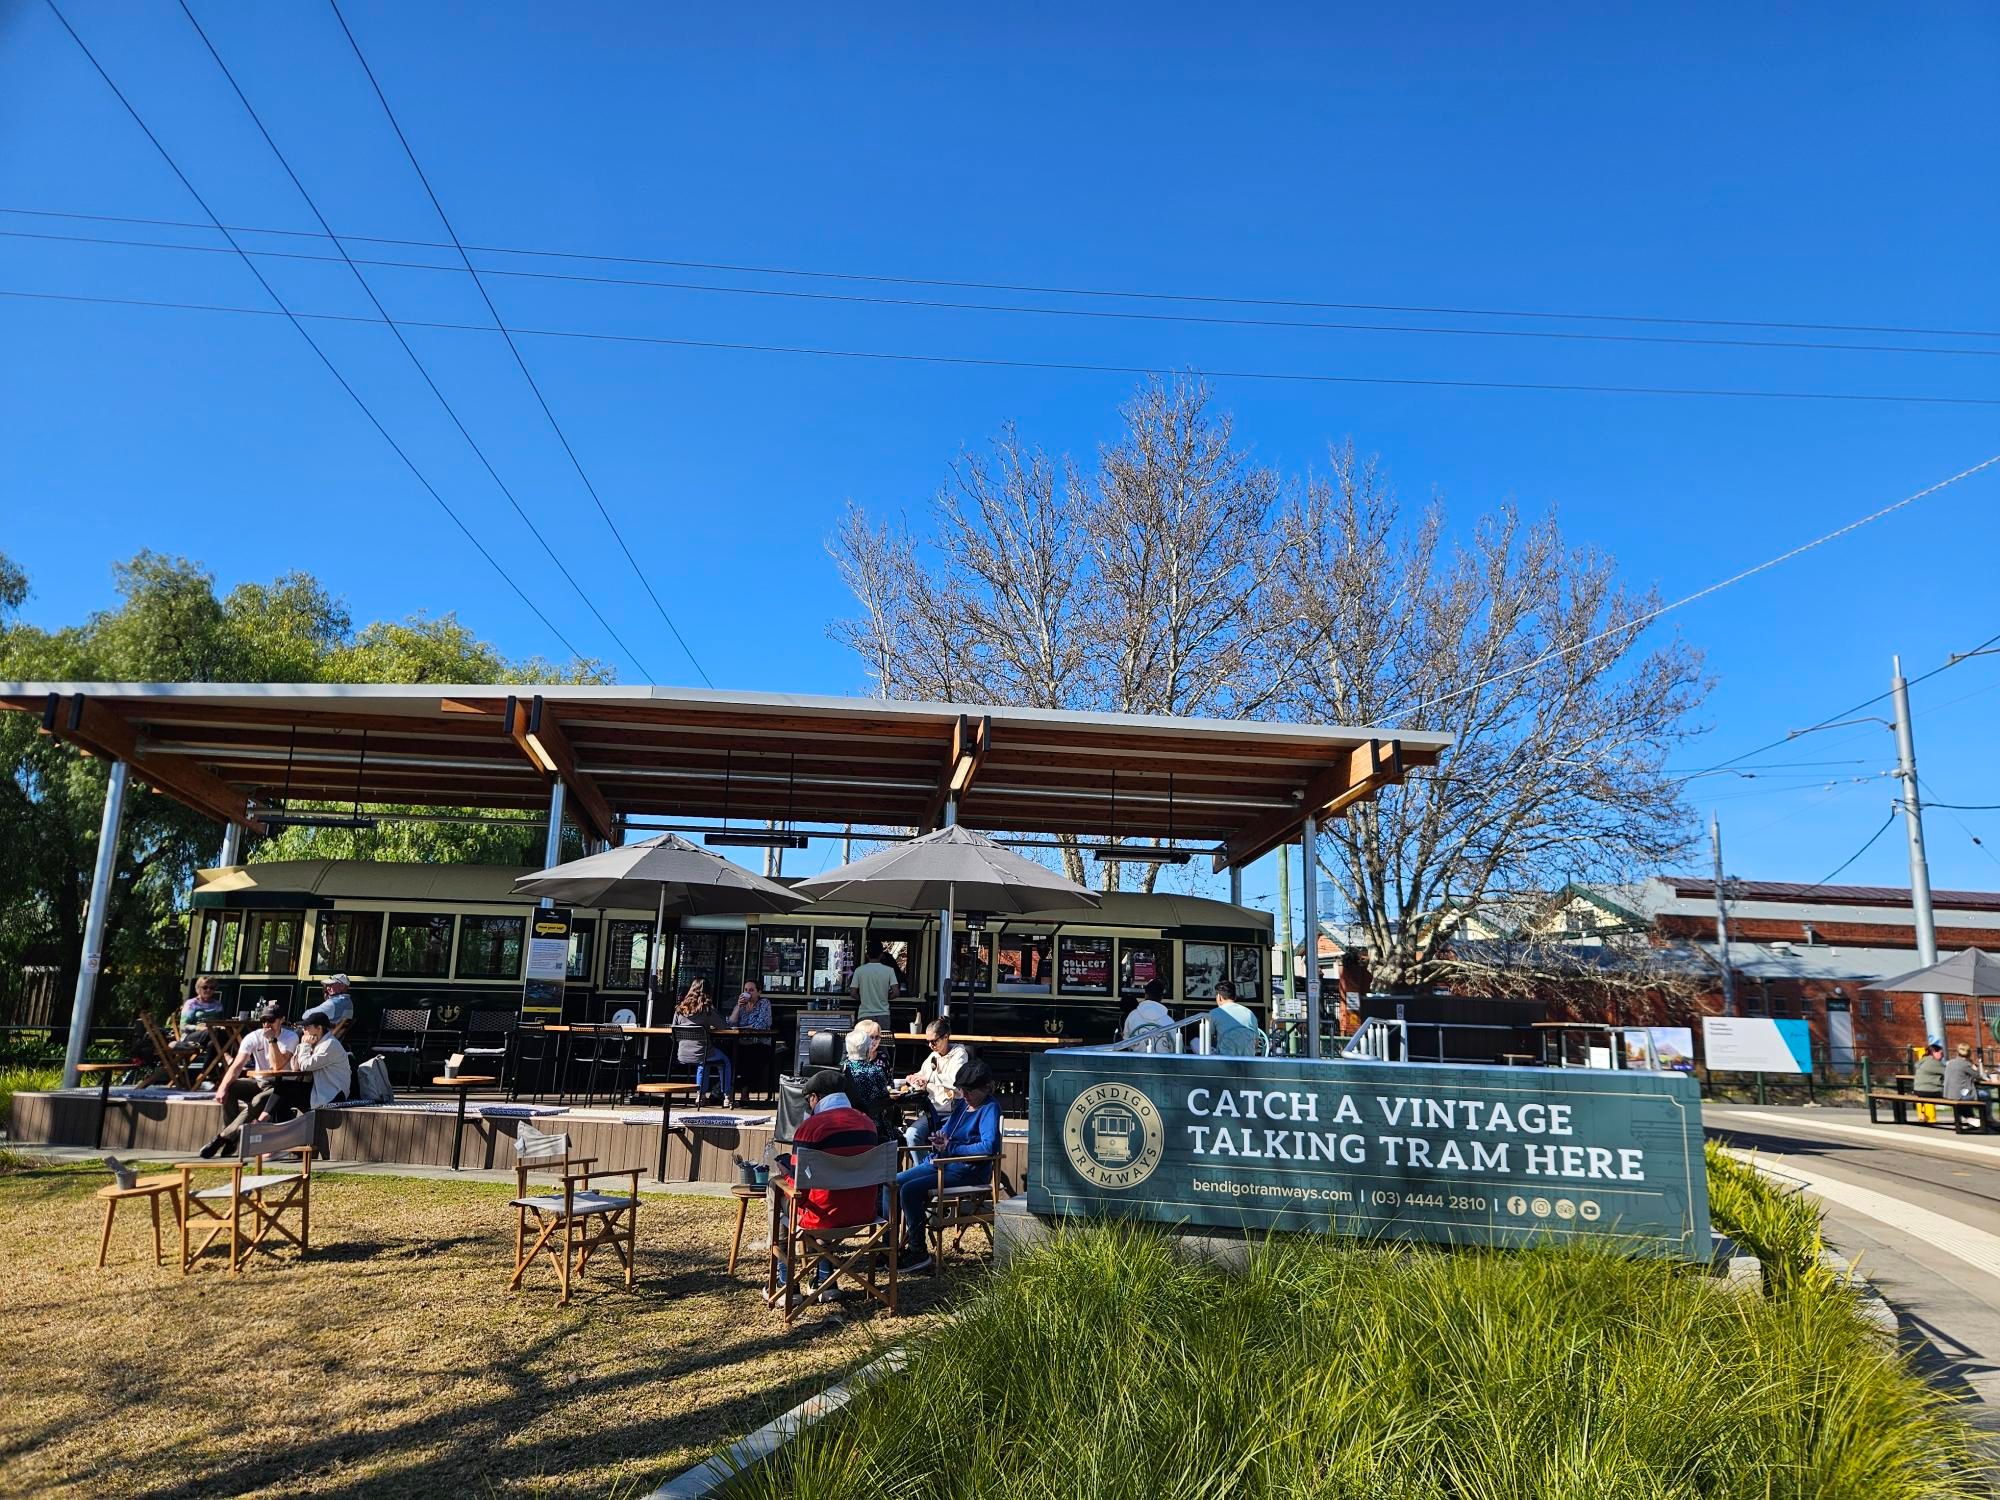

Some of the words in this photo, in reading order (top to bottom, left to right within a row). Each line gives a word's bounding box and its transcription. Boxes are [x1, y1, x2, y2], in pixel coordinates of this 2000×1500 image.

[1062, 967, 1088, 975] HERE
[1063, 959, 1106, 968] COLLECT
[1076, 1088, 1151, 1116] BENDIGO
[1187, 1088, 1319, 1122] CATCH
[1332, 1094, 1363, 1124] A
[1376, 1096, 1573, 1136] VINTAGE
[1071, 1144, 1157, 1184] TRAMWAYS
[1187, 1125, 1366, 1164] TALKING
[1379, 1136, 1511, 1173] TRAM
[1524, 1143, 1645, 1181] HERE
[1193, 1178, 1352, 1201] bendigotramways.com
[1371, 1189, 1400, 1208] (03)
[1405, 1192, 1444, 1208] 4444
[1448, 1195, 1486, 1211] 2810
